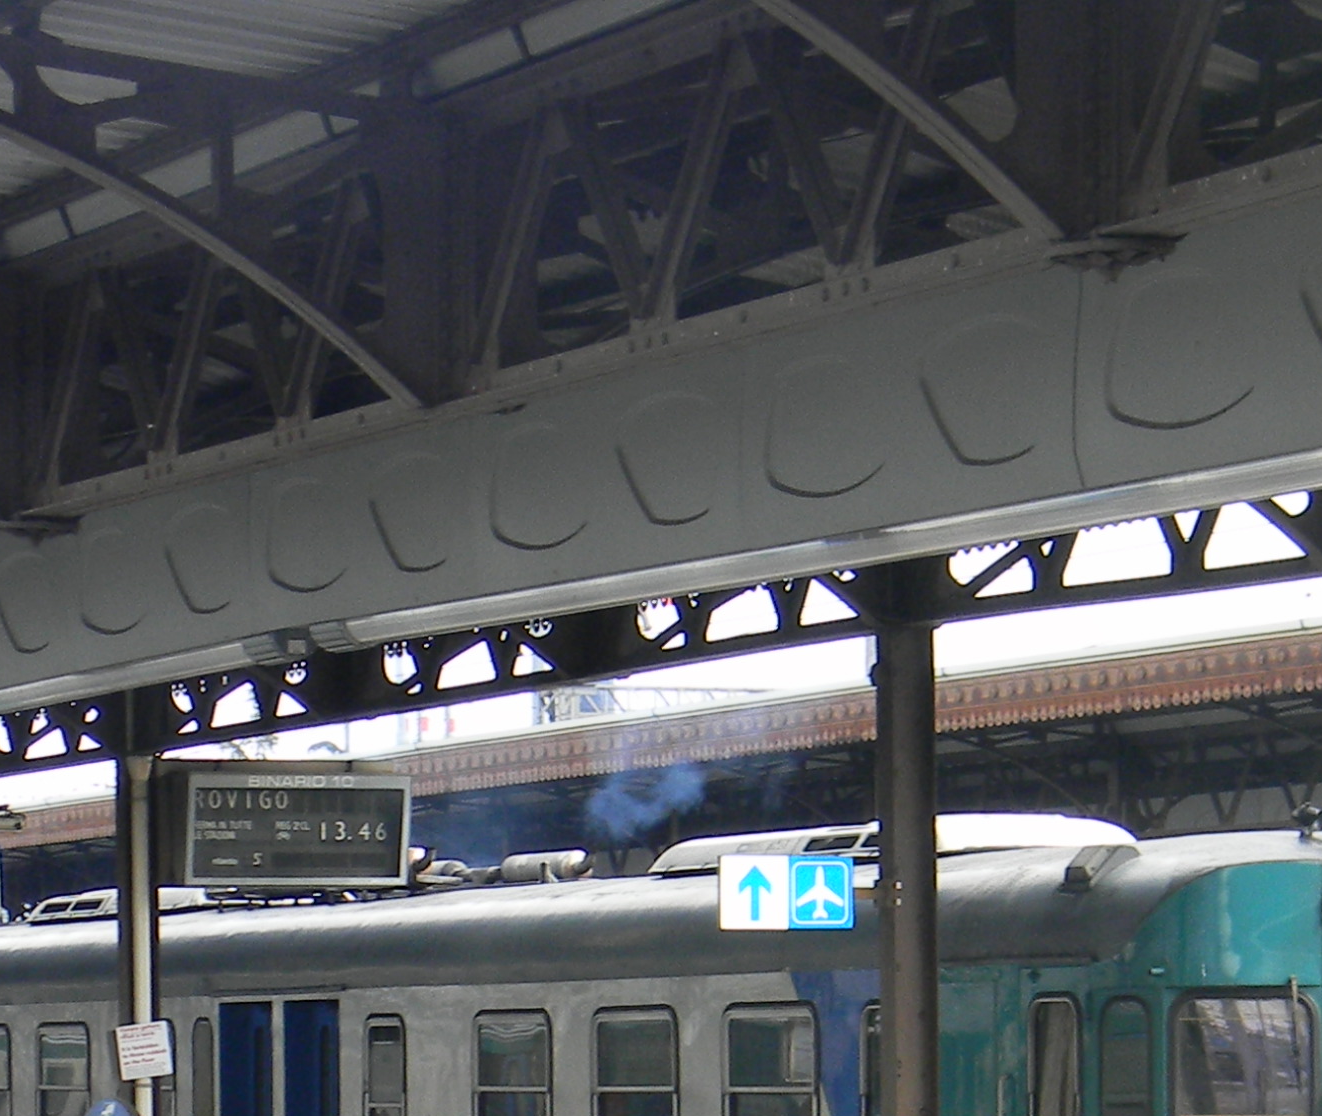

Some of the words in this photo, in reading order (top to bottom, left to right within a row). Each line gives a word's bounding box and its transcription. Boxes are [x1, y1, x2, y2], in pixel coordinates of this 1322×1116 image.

[248, 775, 326, 788] BINARIO
[332, 776, 355, 788] 10
[195, 790, 289, 809] ROVIGO
[319, 822, 388, 842] 13.46
